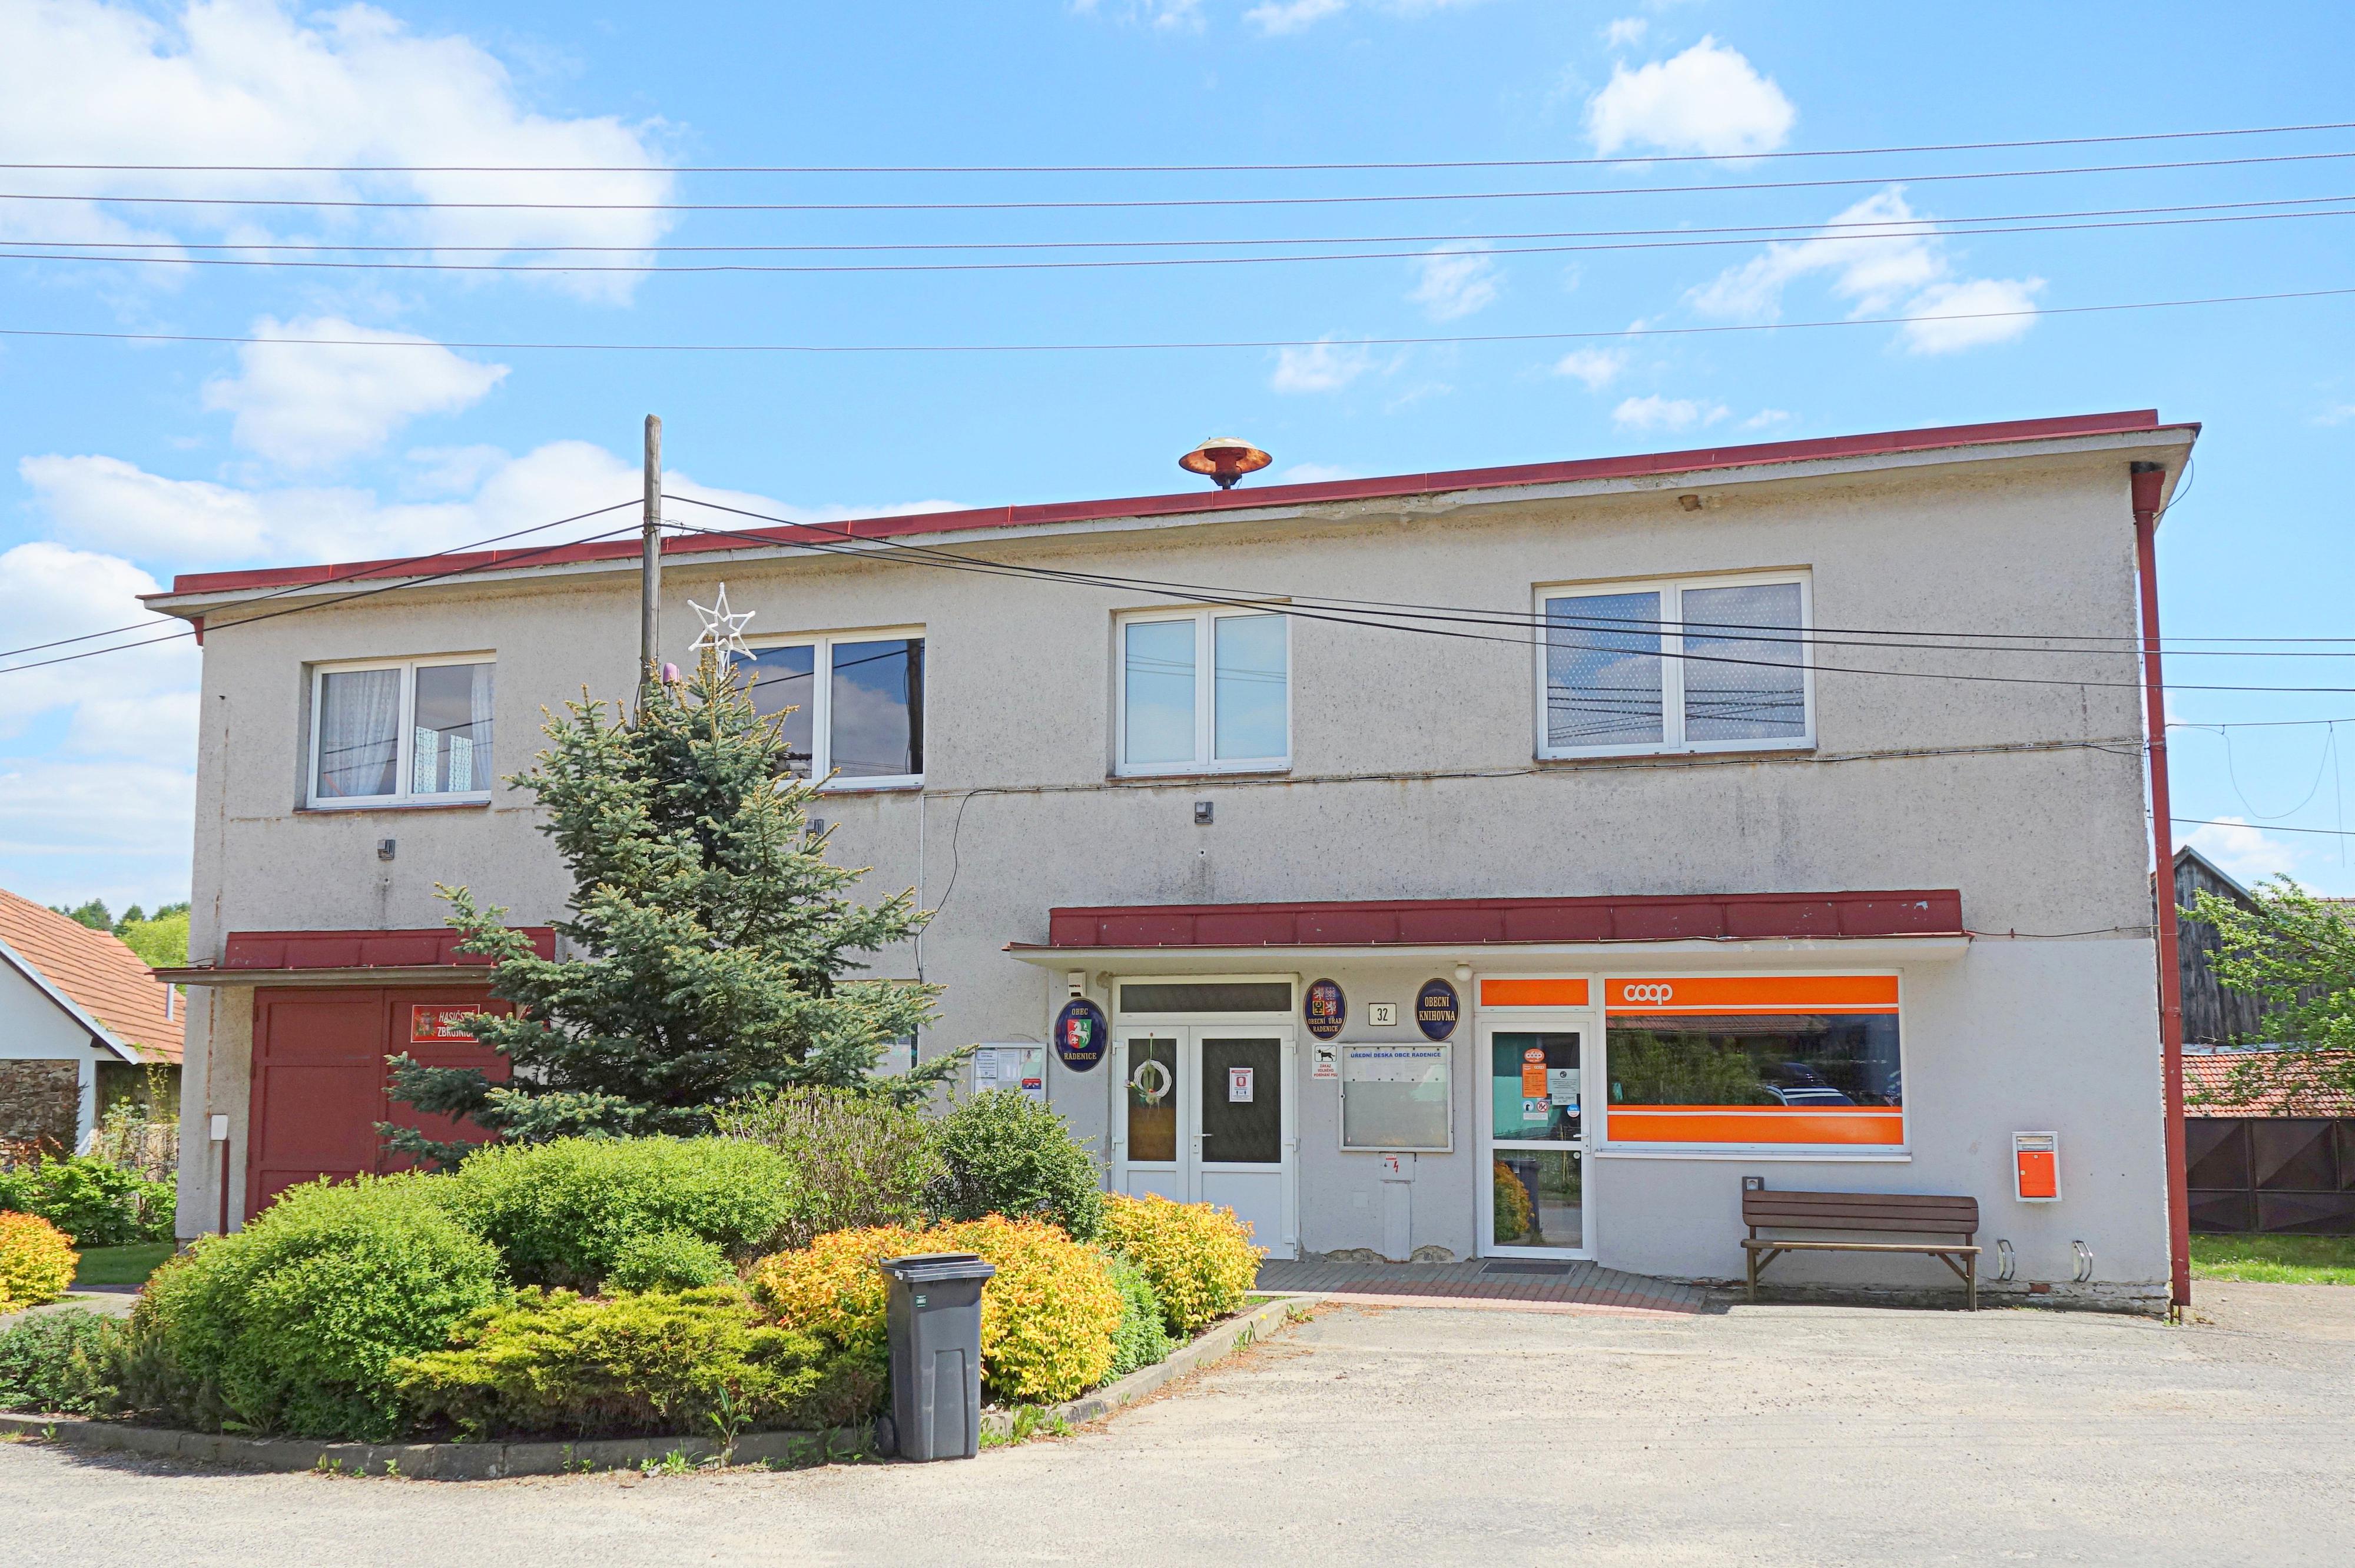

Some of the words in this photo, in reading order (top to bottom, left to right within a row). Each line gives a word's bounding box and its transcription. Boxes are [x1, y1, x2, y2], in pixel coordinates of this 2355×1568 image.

[1425, 994, 1450, 1007] OBECNÍ
[1624, 984, 1673, 1005] coop
[1308, 1016, 1326, 1025] OBECNÍ
[1328, 1016, 1342, 1024] ÚŘAD
[1377, 1008, 1388, 1021] 32
[1419, 1010, 1455, 1021] KNIHOVNA
